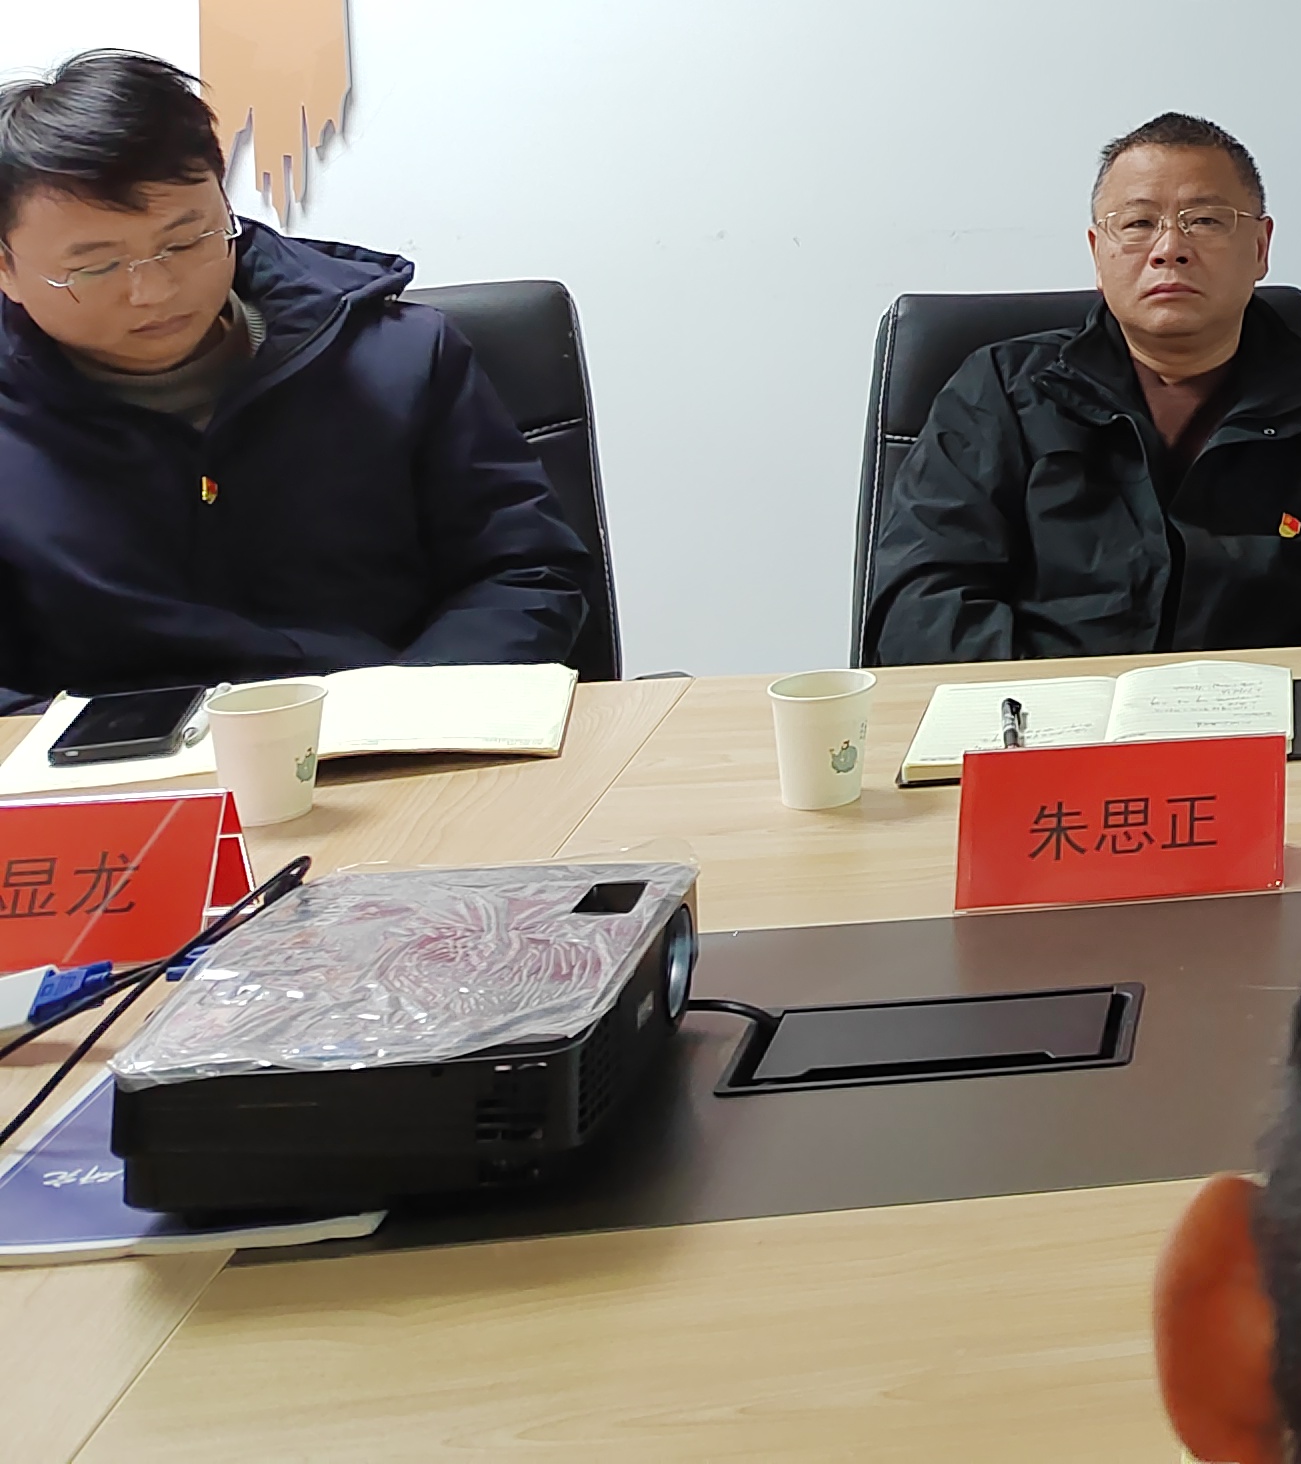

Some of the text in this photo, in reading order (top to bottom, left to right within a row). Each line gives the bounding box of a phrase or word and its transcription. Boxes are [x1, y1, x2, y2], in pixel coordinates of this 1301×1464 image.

[1028, 795, 1217, 860] 朱思正
[0, 851, 140, 918] 显龙
